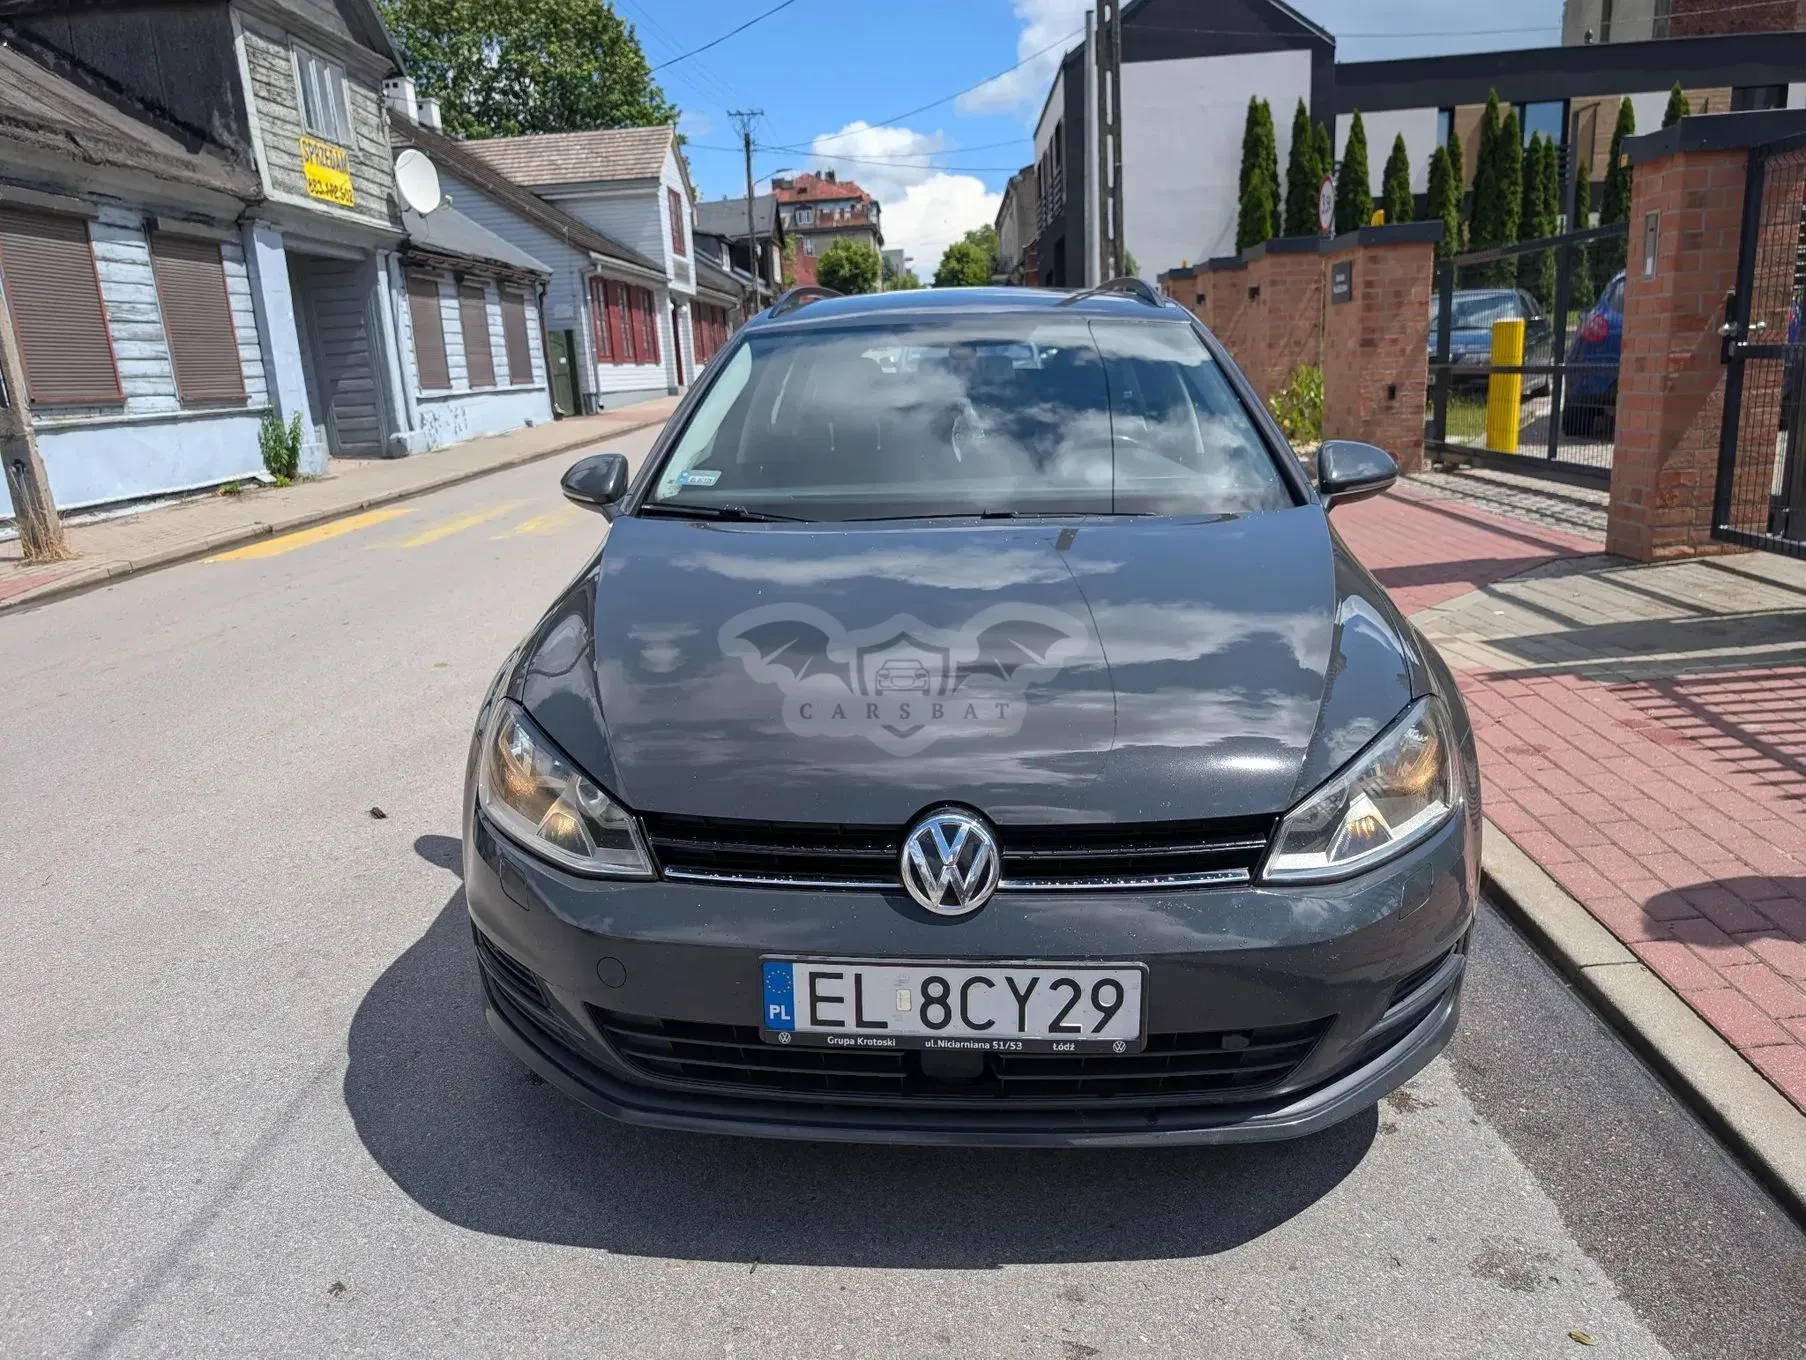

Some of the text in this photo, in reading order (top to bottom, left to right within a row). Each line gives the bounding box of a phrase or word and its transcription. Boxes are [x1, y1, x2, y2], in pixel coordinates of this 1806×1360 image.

[808, 971, 1125, 1034] EL 8CY29
[769, 1004, 791, 1021] PL
[827, 1036, 896, 1047] Grupa Krotoski
[992, 1041, 1023, 1051] 51/53
[1053, 1042, 1076, 1051] Łódź
